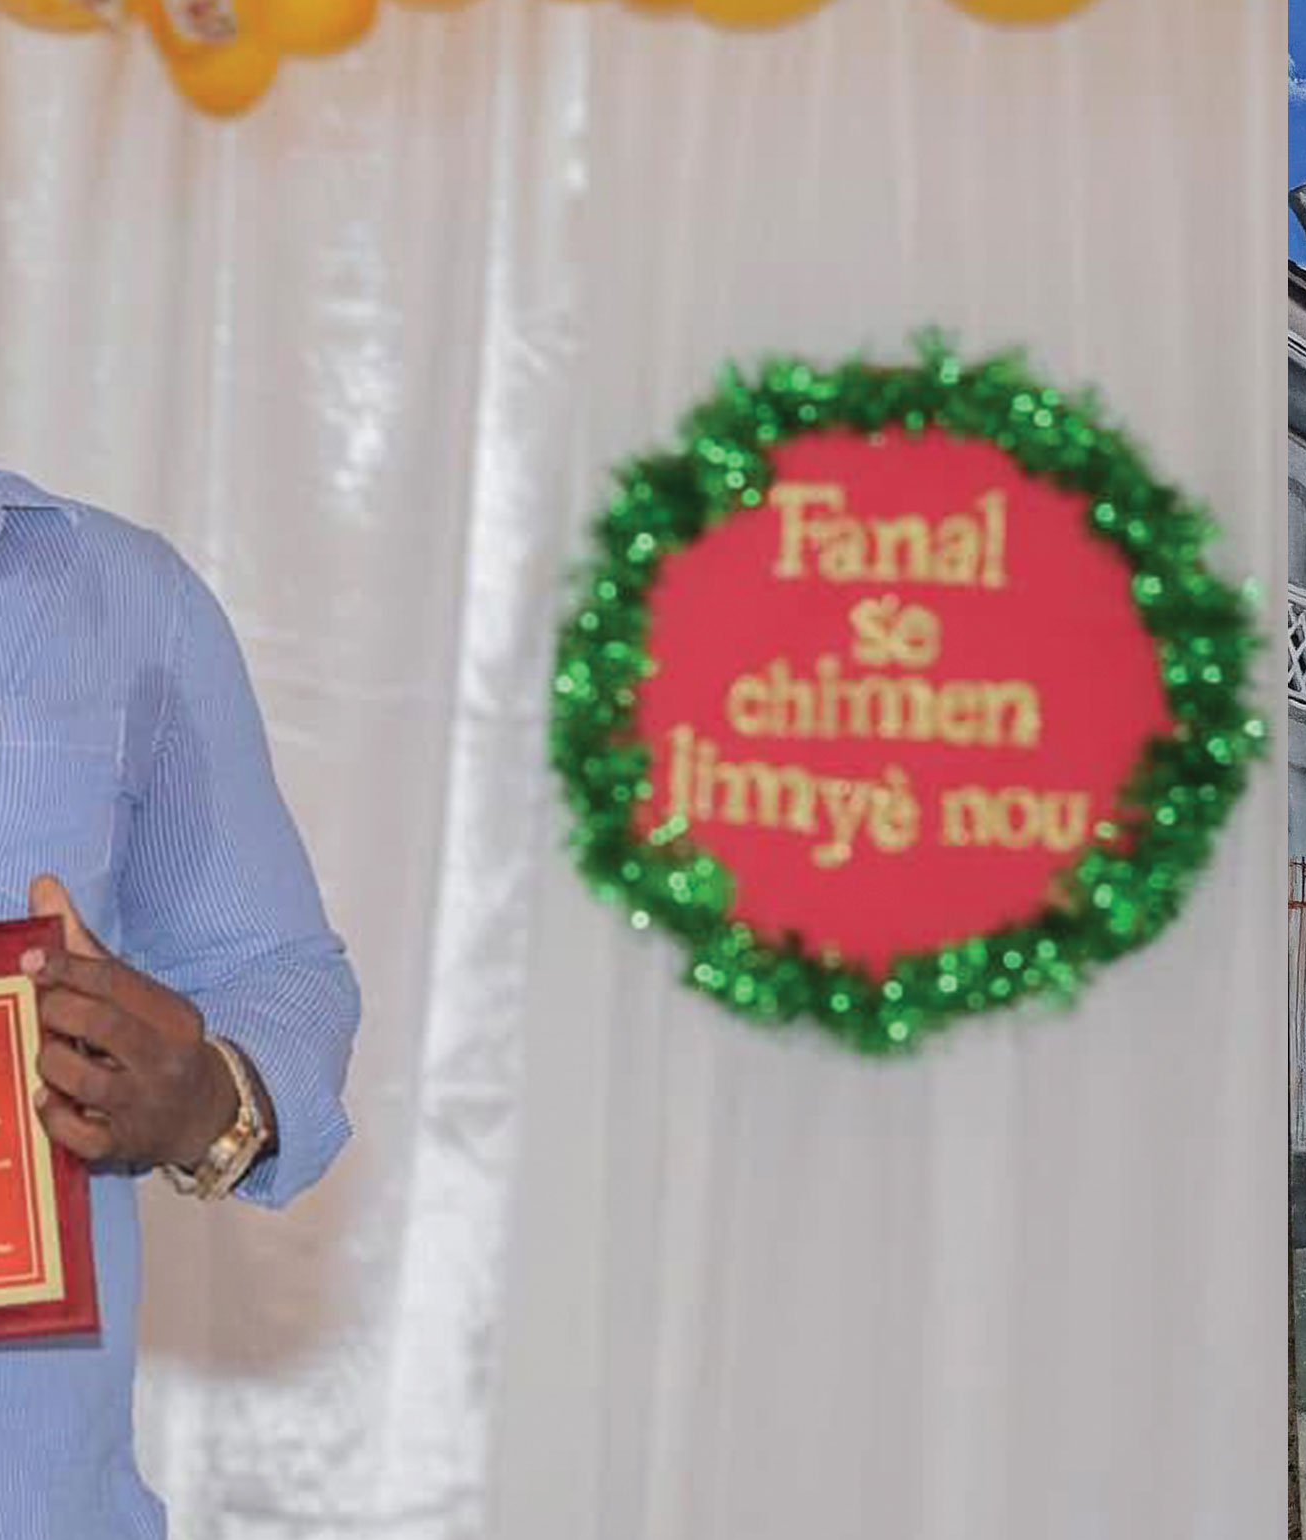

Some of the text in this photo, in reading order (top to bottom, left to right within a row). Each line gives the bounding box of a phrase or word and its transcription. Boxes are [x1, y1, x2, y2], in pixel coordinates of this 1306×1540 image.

[770, 481, 1007, 589] Fanal
[726, 656, 1042, 748] chimen
[940, 785, 1093, 853] nou
